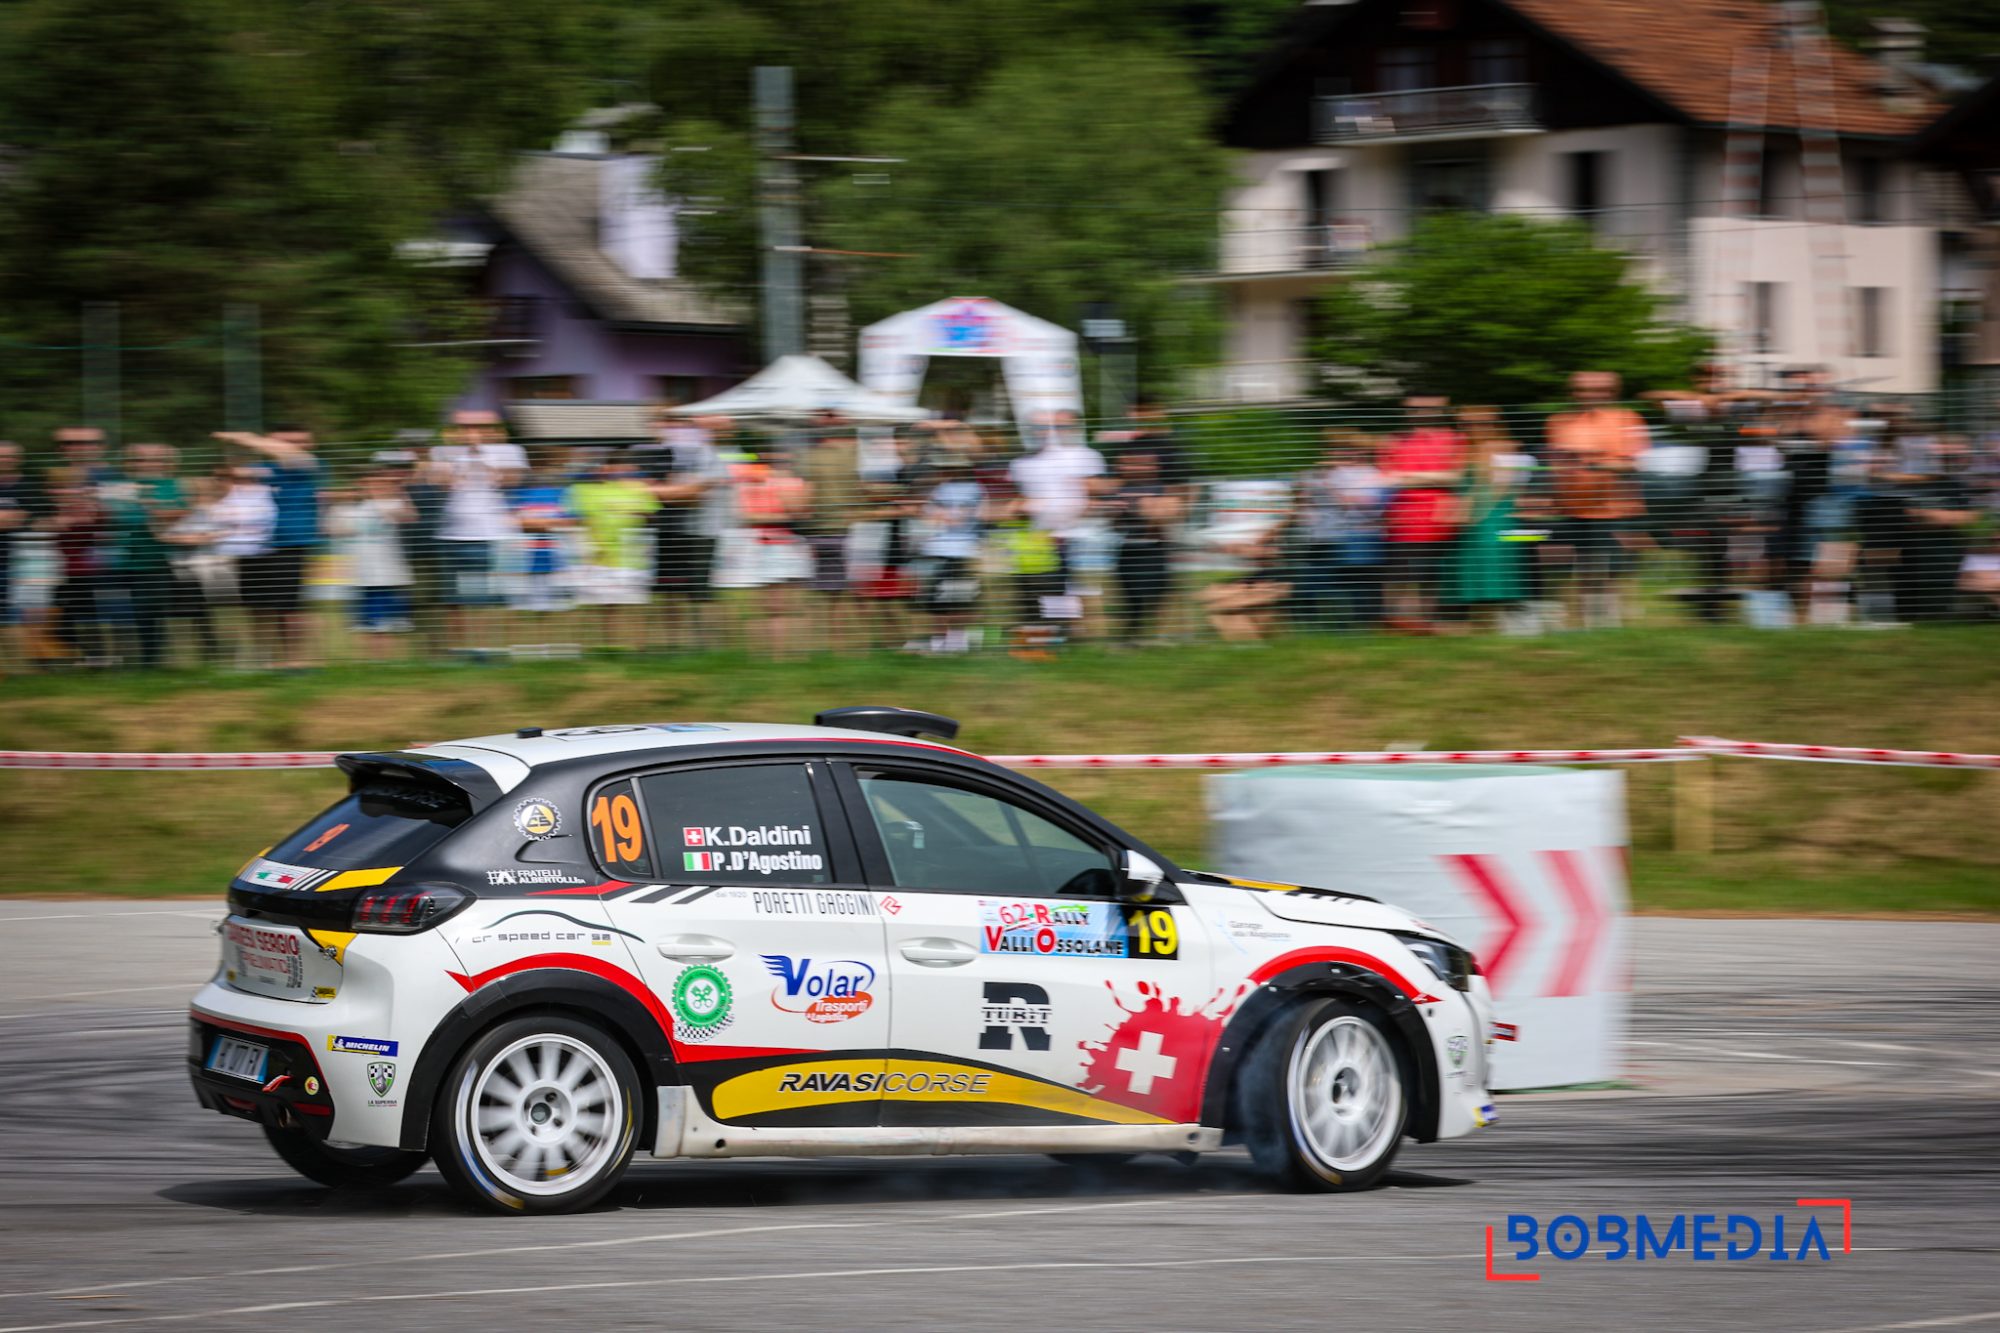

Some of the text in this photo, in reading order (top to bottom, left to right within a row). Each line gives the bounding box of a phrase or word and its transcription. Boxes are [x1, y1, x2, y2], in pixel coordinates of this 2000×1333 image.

[592, 794, 643, 863] 19
[704, 825, 812, 847] K.Daldini
[517, 869, 562, 877] FRATELLI
[712, 850, 823, 875] P.D'Agostino
[519, 876, 577, 884] ALBERTOLLI
[753, 891, 880, 916] PORETTI GAGGINI
[1034, 904, 1090, 925] RALLY
[255, 931, 299, 956] SERGIO
[472, 935, 493, 943] cr
[498, 932, 550, 942] speed
[556, 932, 586, 940] car
[984, 925, 1124, 954] VALLI OSSOLANE
[1128, 910, 1179, 955] 19
[758, 954, 864, 998] Volar
[345, 1041, 390, 1052] MICHELIN
[777, 1072, 993, 1093] RAVASICORSE
